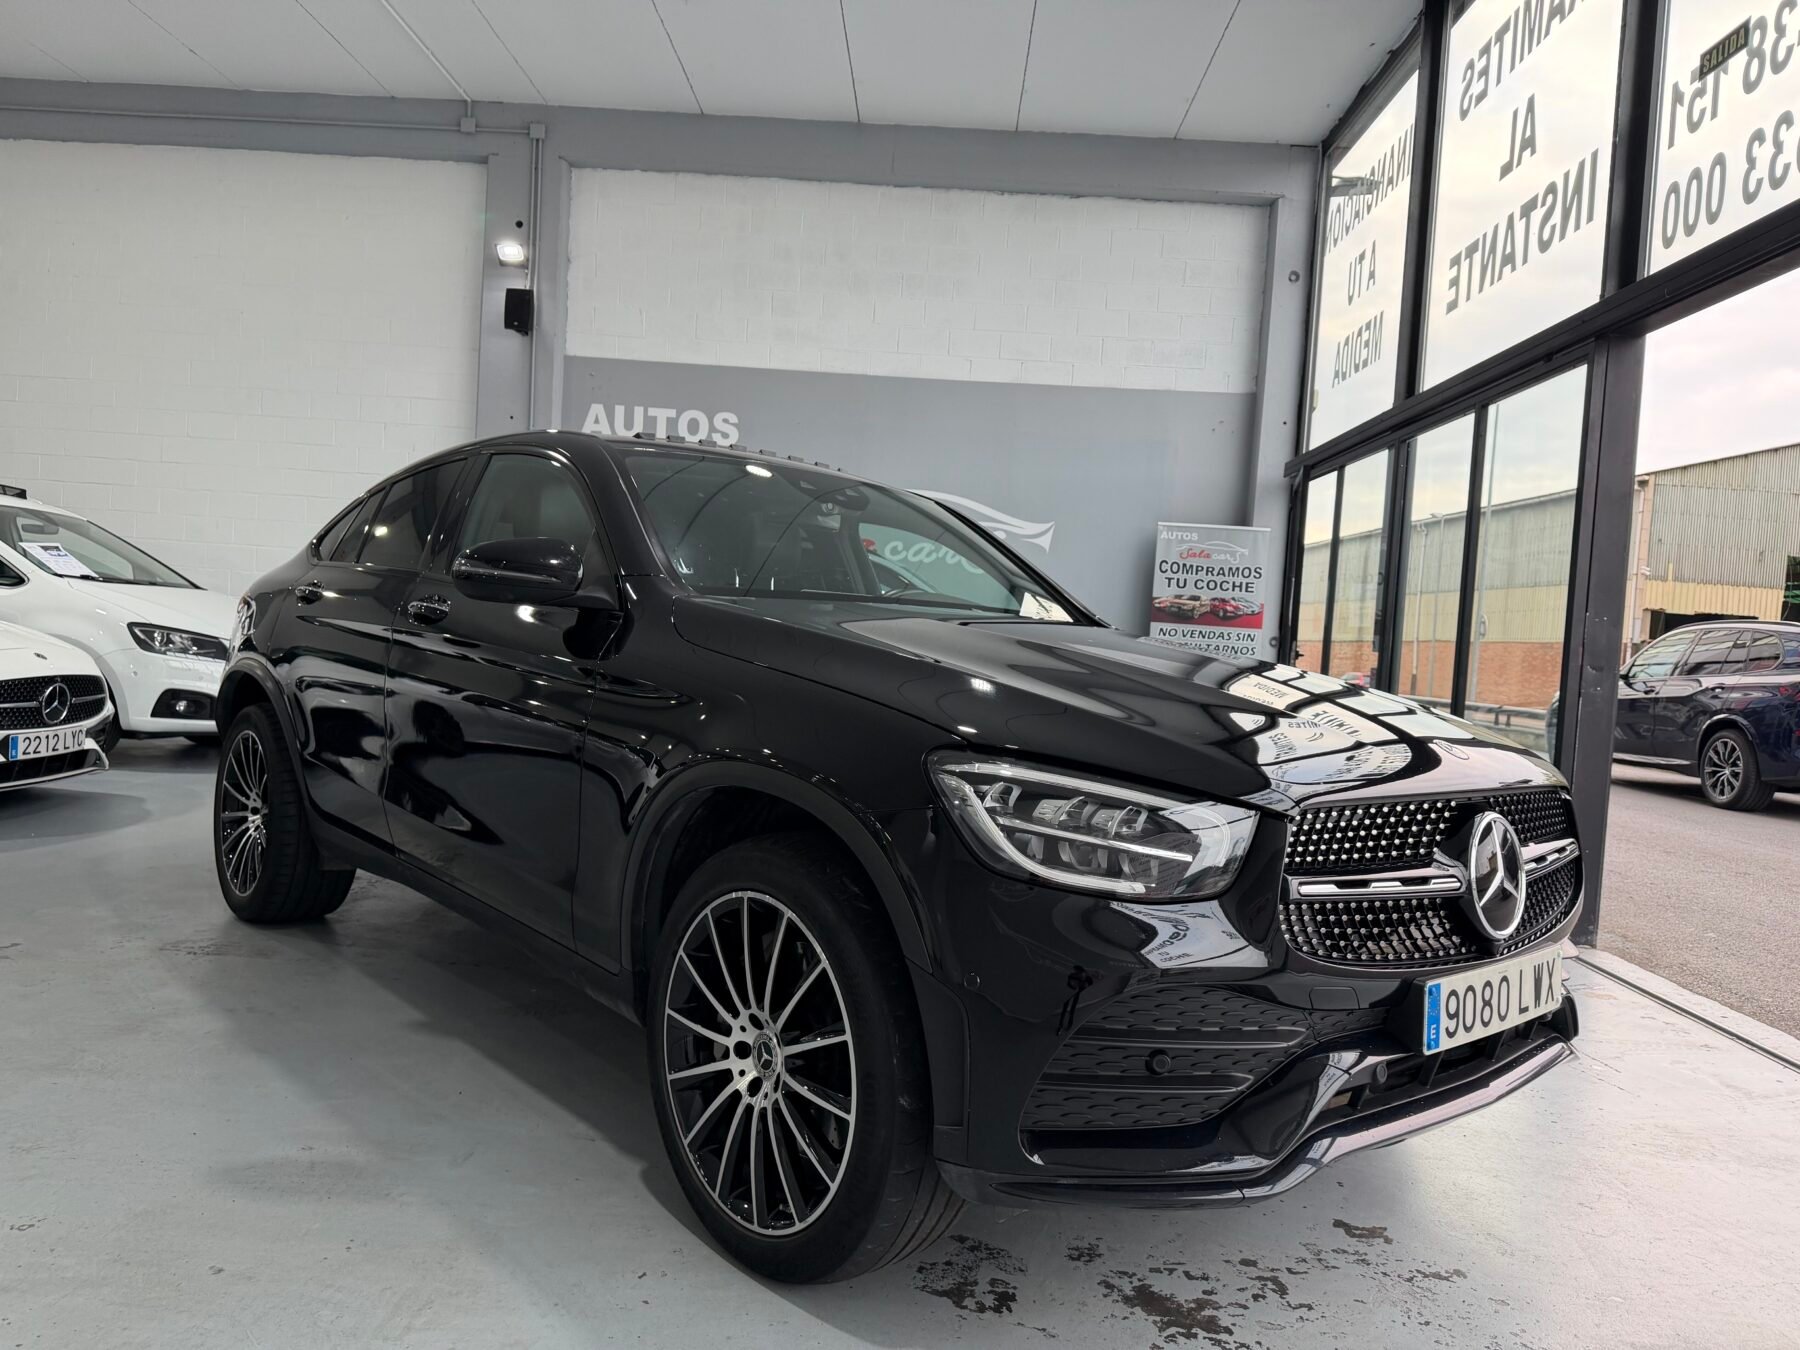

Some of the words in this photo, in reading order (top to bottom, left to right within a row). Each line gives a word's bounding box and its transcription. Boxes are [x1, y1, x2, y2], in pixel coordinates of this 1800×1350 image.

[1701, 26, 1747, 74] SALIDA
[581, 403, 739, 447] AUTOS
[1160, 530, 1199, 541] AUTOS
[1158, 559, 1263, 580] COMPRAMOS
[1164, 577, 1188, 589] TU
[1193, 578, 1256, 594] COCHE
[1158, 627, 1178, 638] NO
[1180, 628, 1232, 642] VENDAS
[1235, 631, 1256, 643] SIN
[22, 734, 60, 756] 2212
[63, 729, 84, 750] LYC
[1430, 1024, 1437, 1039] E
[1444, 974, 1510, 1040] 9080
[1518, 957, 1556, 1016] LWX
